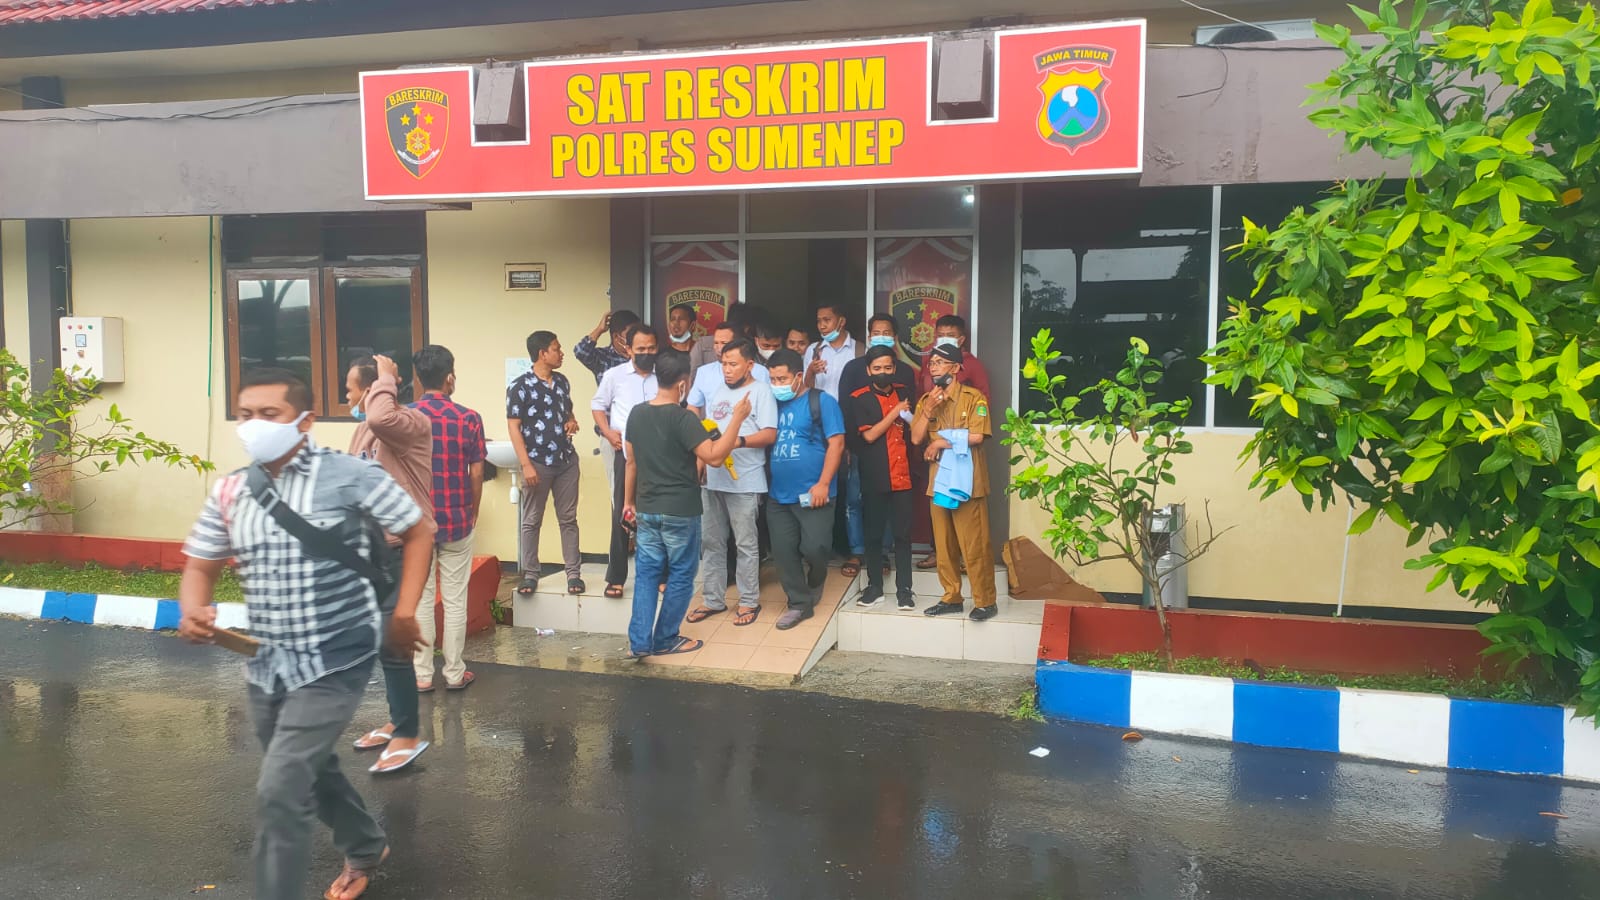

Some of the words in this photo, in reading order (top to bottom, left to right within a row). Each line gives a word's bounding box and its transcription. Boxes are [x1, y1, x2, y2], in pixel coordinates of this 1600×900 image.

[1040, 50, 1071, 66] JAWA
[1073, 49, 1109, 61] TIMUR
[389, 89, 444, 106] BARESKRIM
[567, 71, 651, 126] SAT
[664, 55, 886, 121] RESKRIM
[551, 128, 696, 178] POLRES
[707, 118, 905, 173] SUMENEP
[671, 290, 722, 304] BARESKRIM
[895, 287, 950, 301] BARESKRIM
[777, 429, 797, 442] EN
